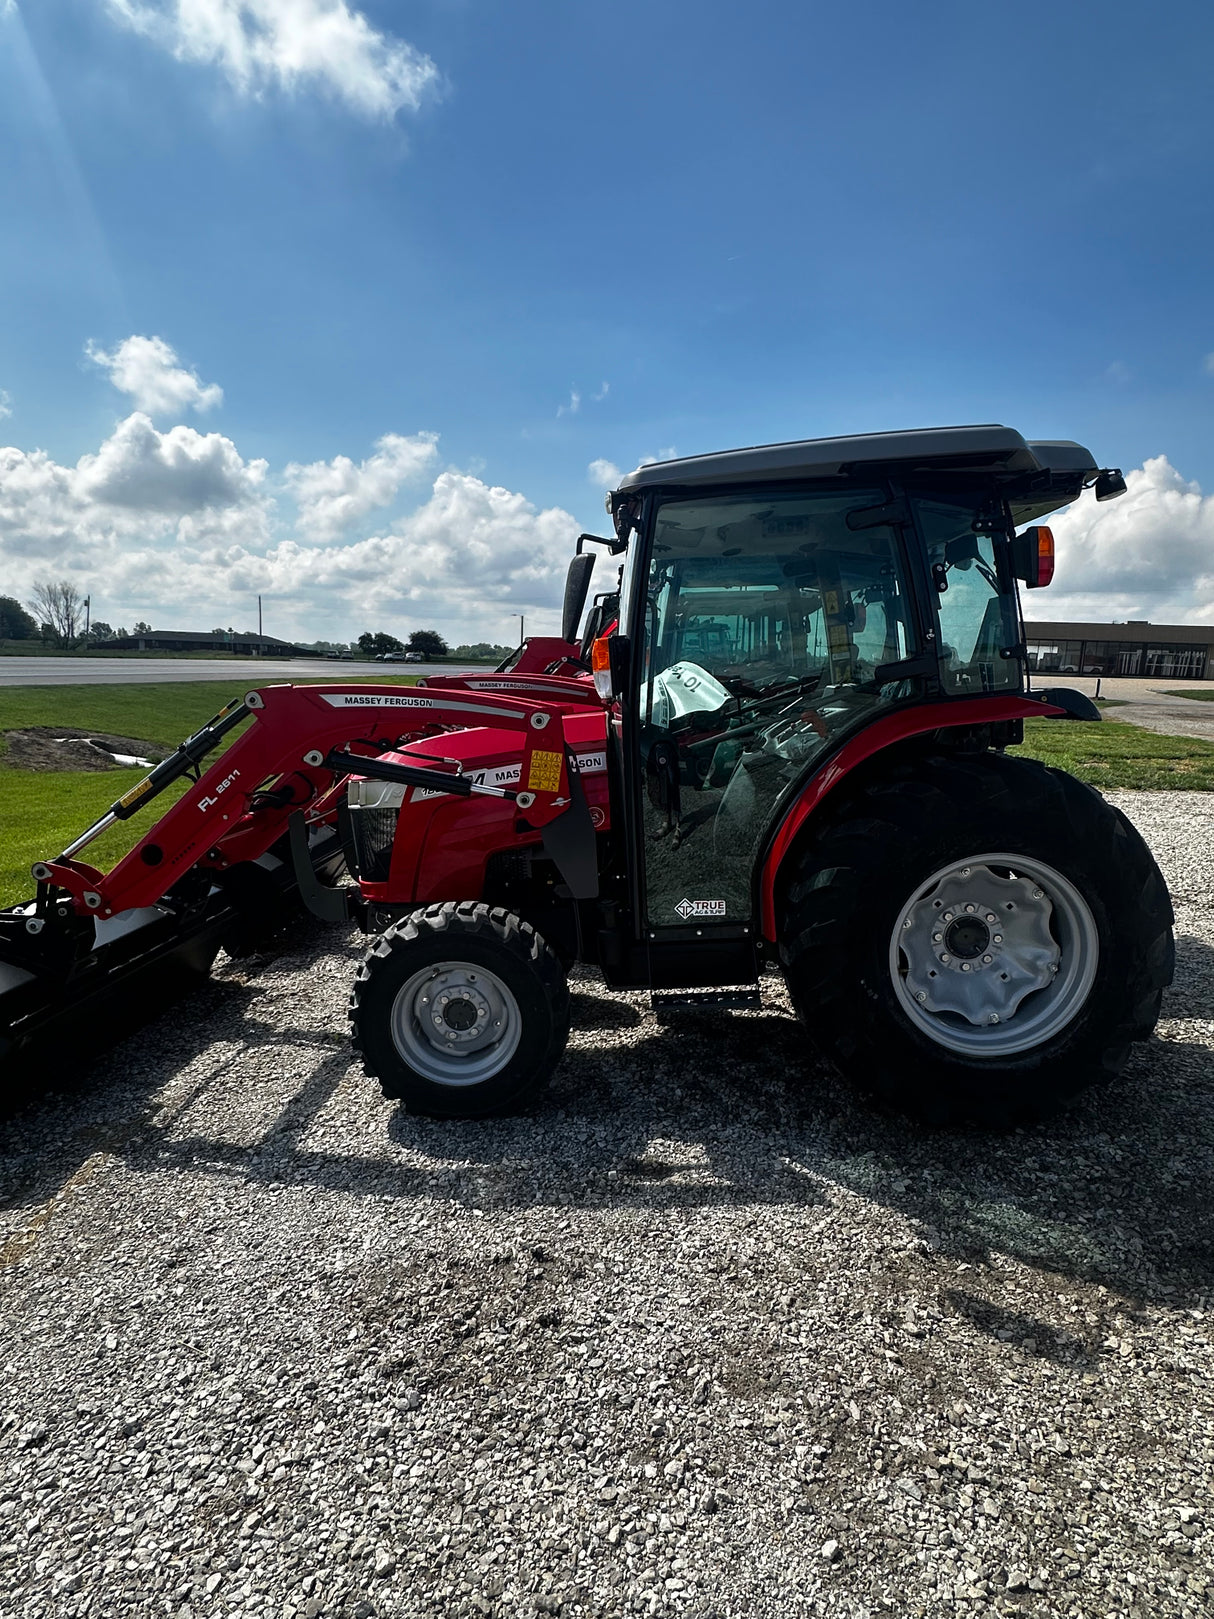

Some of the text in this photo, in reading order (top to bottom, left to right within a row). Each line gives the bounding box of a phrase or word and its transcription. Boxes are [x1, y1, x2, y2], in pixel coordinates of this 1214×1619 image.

[344, 696, 433, 707] MASSEY FERGUSON
[495, 769, 520, 781] MAS
[197, 769, 241, 812] FL 2611
[695, 901, 724, 910] TRUE
